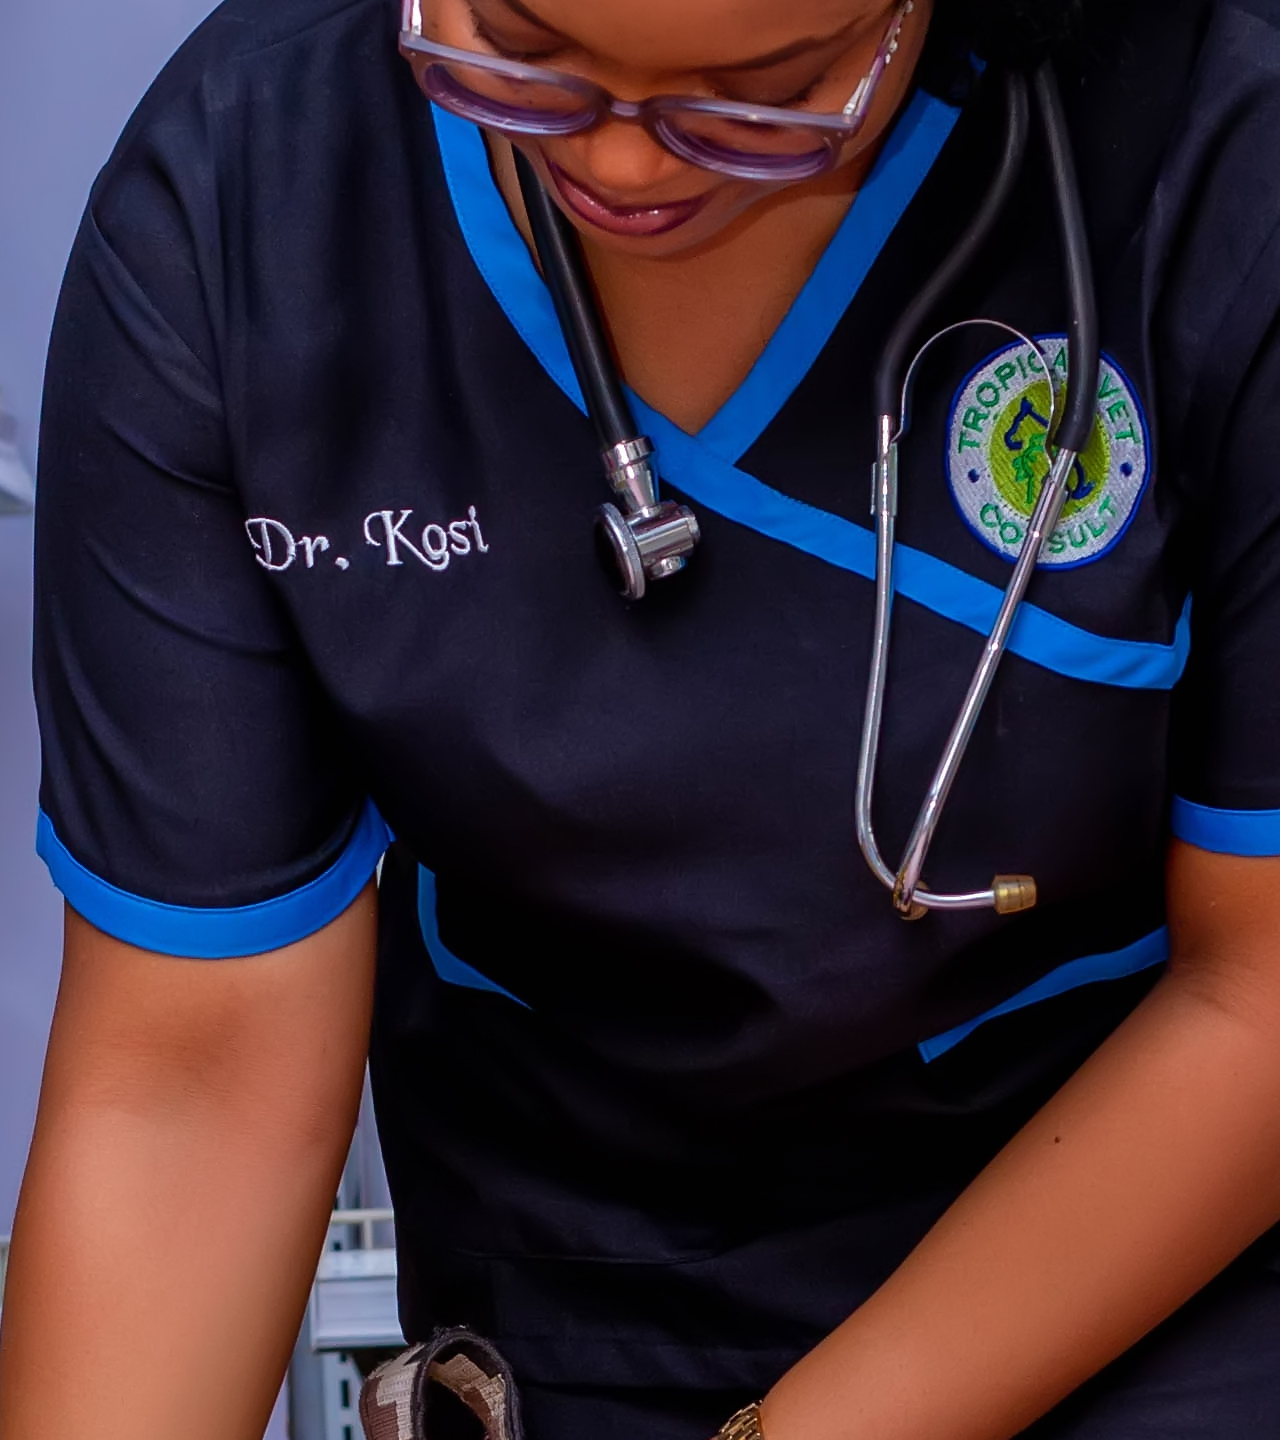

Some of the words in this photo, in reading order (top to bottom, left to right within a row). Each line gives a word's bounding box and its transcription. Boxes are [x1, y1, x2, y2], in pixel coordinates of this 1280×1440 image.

[958, 346, 1068, 454] TROPICA
[1097, 373, 1141, 446] VET
[245, 515, 350, 573] Dr.
[363, 504, 490, 572] Kosi
[979, 495, 1118, 554] COSULT
